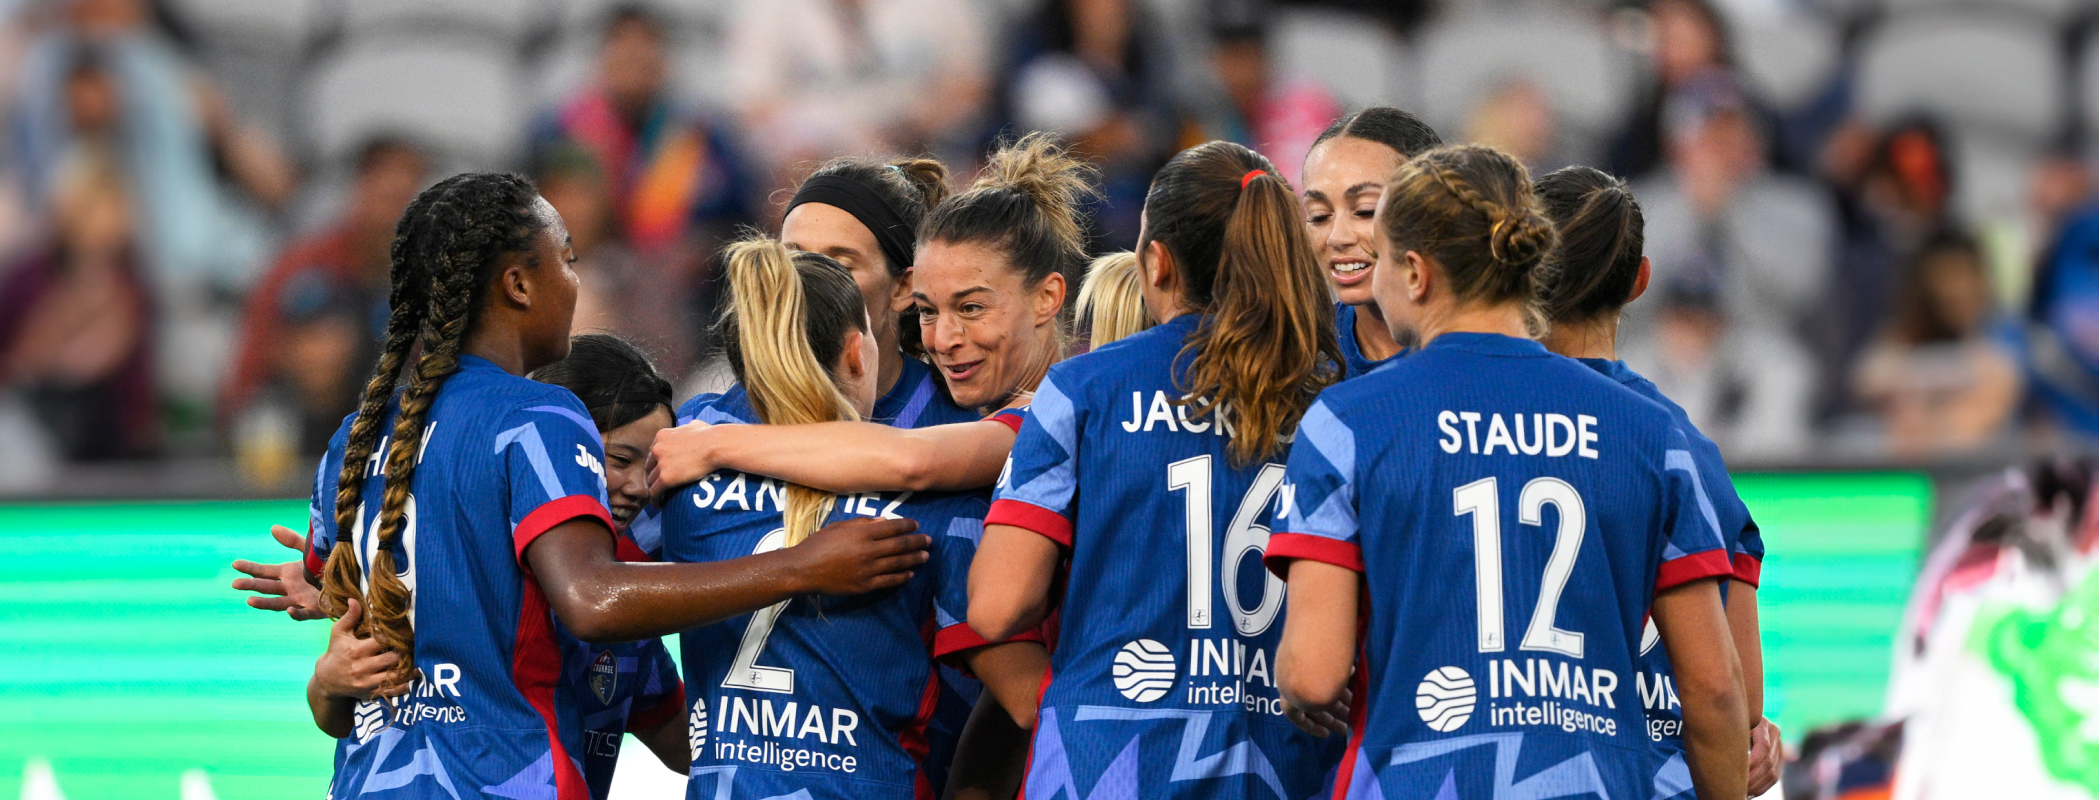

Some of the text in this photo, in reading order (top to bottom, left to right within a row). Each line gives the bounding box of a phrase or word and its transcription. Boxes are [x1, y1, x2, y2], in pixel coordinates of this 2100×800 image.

[1437, 410, 1599, 460] STAUDE
[693, 472, 914, 520] SANEZ
[1168, 454, 1288, 637] 16
[1453, 476, 1586, 659] 12
[720, 527, 795, 695] 2
[1190, 638, 1278, 689] INA
[1489, 658, 1618, 709] INMAR
[584, 729, 618, 758] TICS
[716, 696, 859, 746] INMAR
[1490, 701, 1617, 736] intelligence
[715, 736, 857, 773] intelligence
